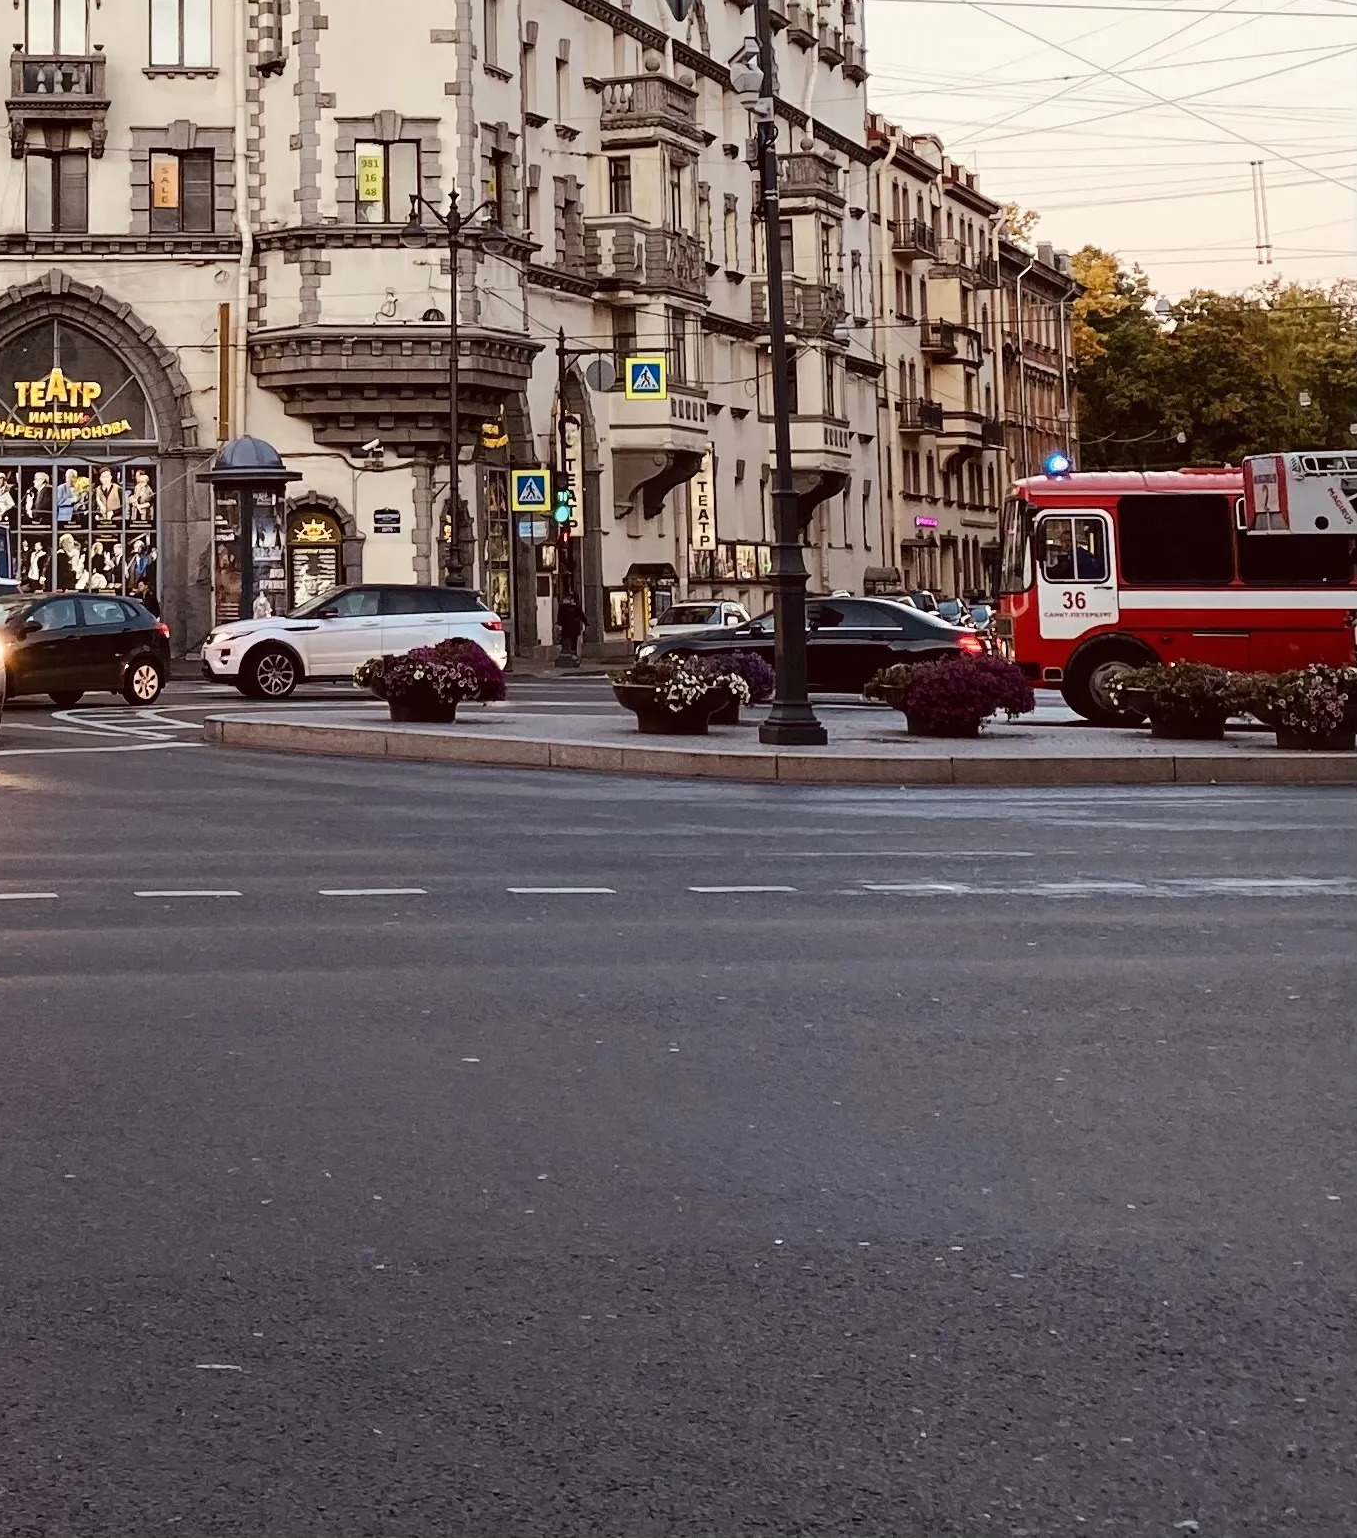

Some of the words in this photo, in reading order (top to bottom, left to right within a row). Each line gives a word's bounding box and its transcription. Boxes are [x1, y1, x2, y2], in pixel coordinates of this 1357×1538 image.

[365, 174, 377, 182] 16
[14, 368, 101, 407] ТЕАТР
[28, 412, 85, 424] ИМЕНИ
[45, 419, 132, 440] МИРОНОВА
[697, 481, 710, 547] ТЕАТР
[1062, 591, 1086, 609] 36
